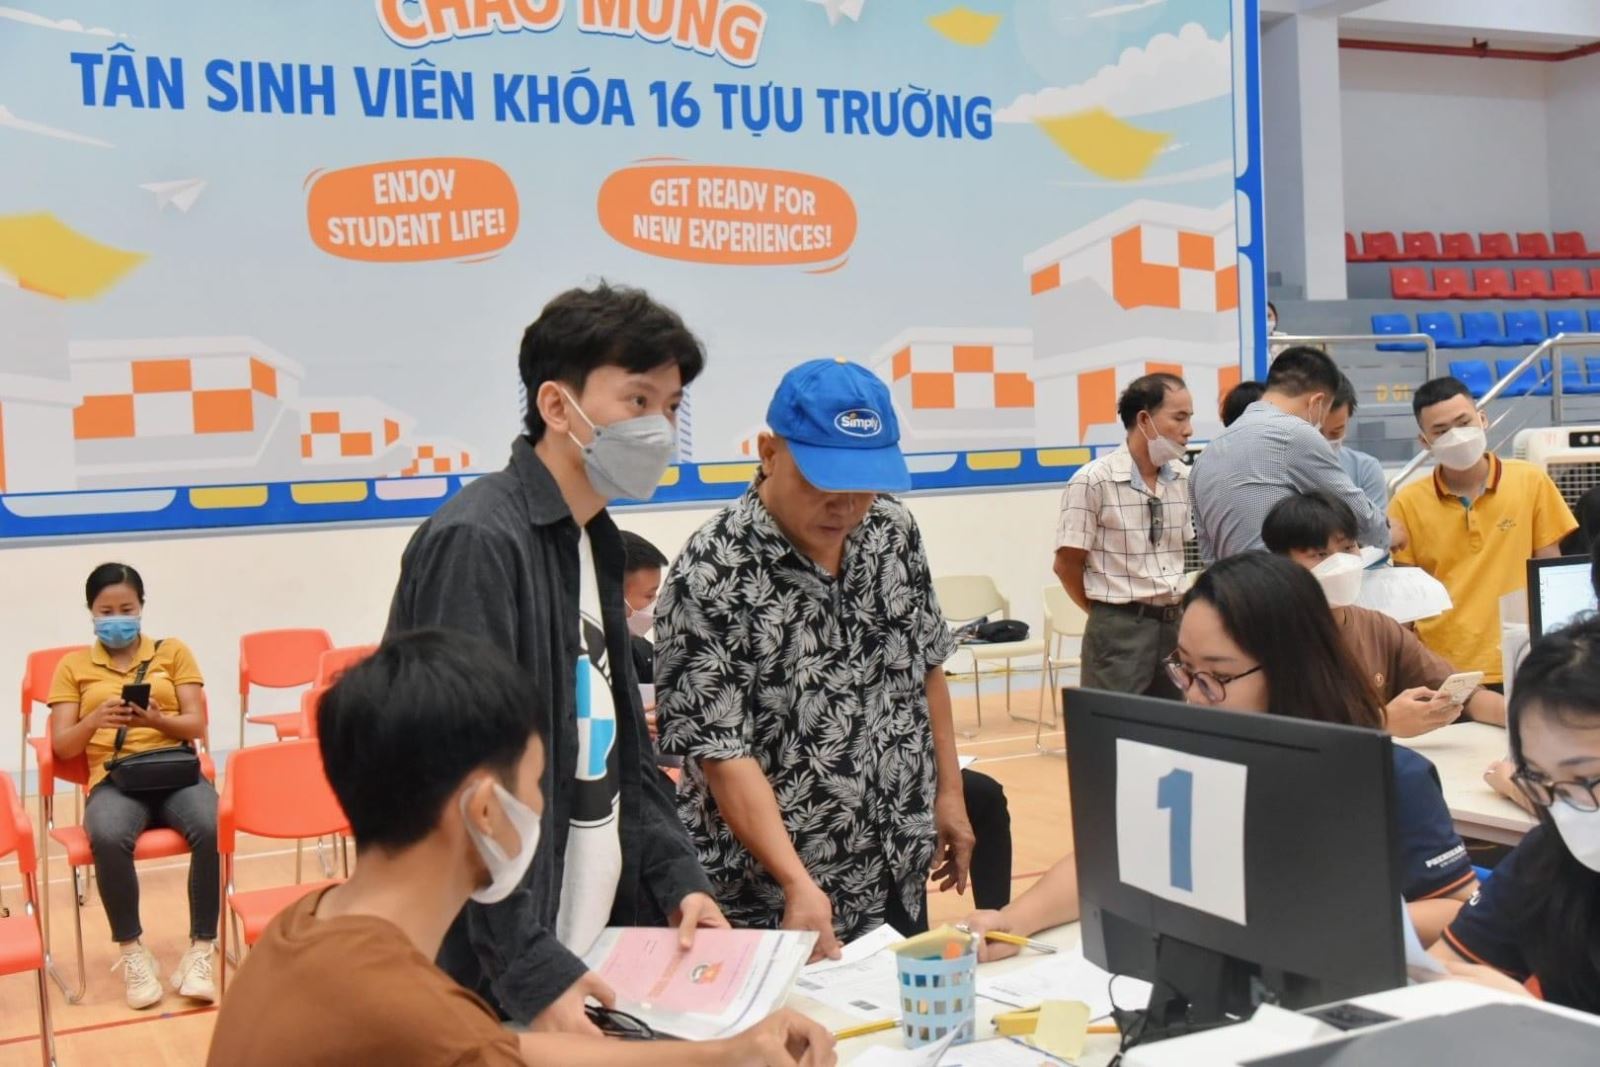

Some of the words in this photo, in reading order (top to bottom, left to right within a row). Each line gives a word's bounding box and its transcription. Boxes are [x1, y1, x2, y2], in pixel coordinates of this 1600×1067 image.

[70, 41, 185, 110] TÂN
[204, 59, 336, 116] SINH
[353, 58, 475, 121] VIÊN
[493, 67, 635, 126] KHÓA
[649, 80, 701, 129] 16
[713, 81, 804, 137] TỰU
[816, 84, 993, 141] TRƯỜNG
[373, 168, 455, 204] ENJOY
[650, 178, 691, 207] GET
[697, 178, 768, 212] READY
[773, 184, 816, 216] FOR
[327, 212, 442, 247] STUDENT
[450, 208, 507, 242] LIFE!
[633, 214, 682, 245] NEW
[688, 218, 832, 253] EXPERIENCES!
[841, 412, 879, 431] Simply
[1157, 767, 1193, 892] 1
